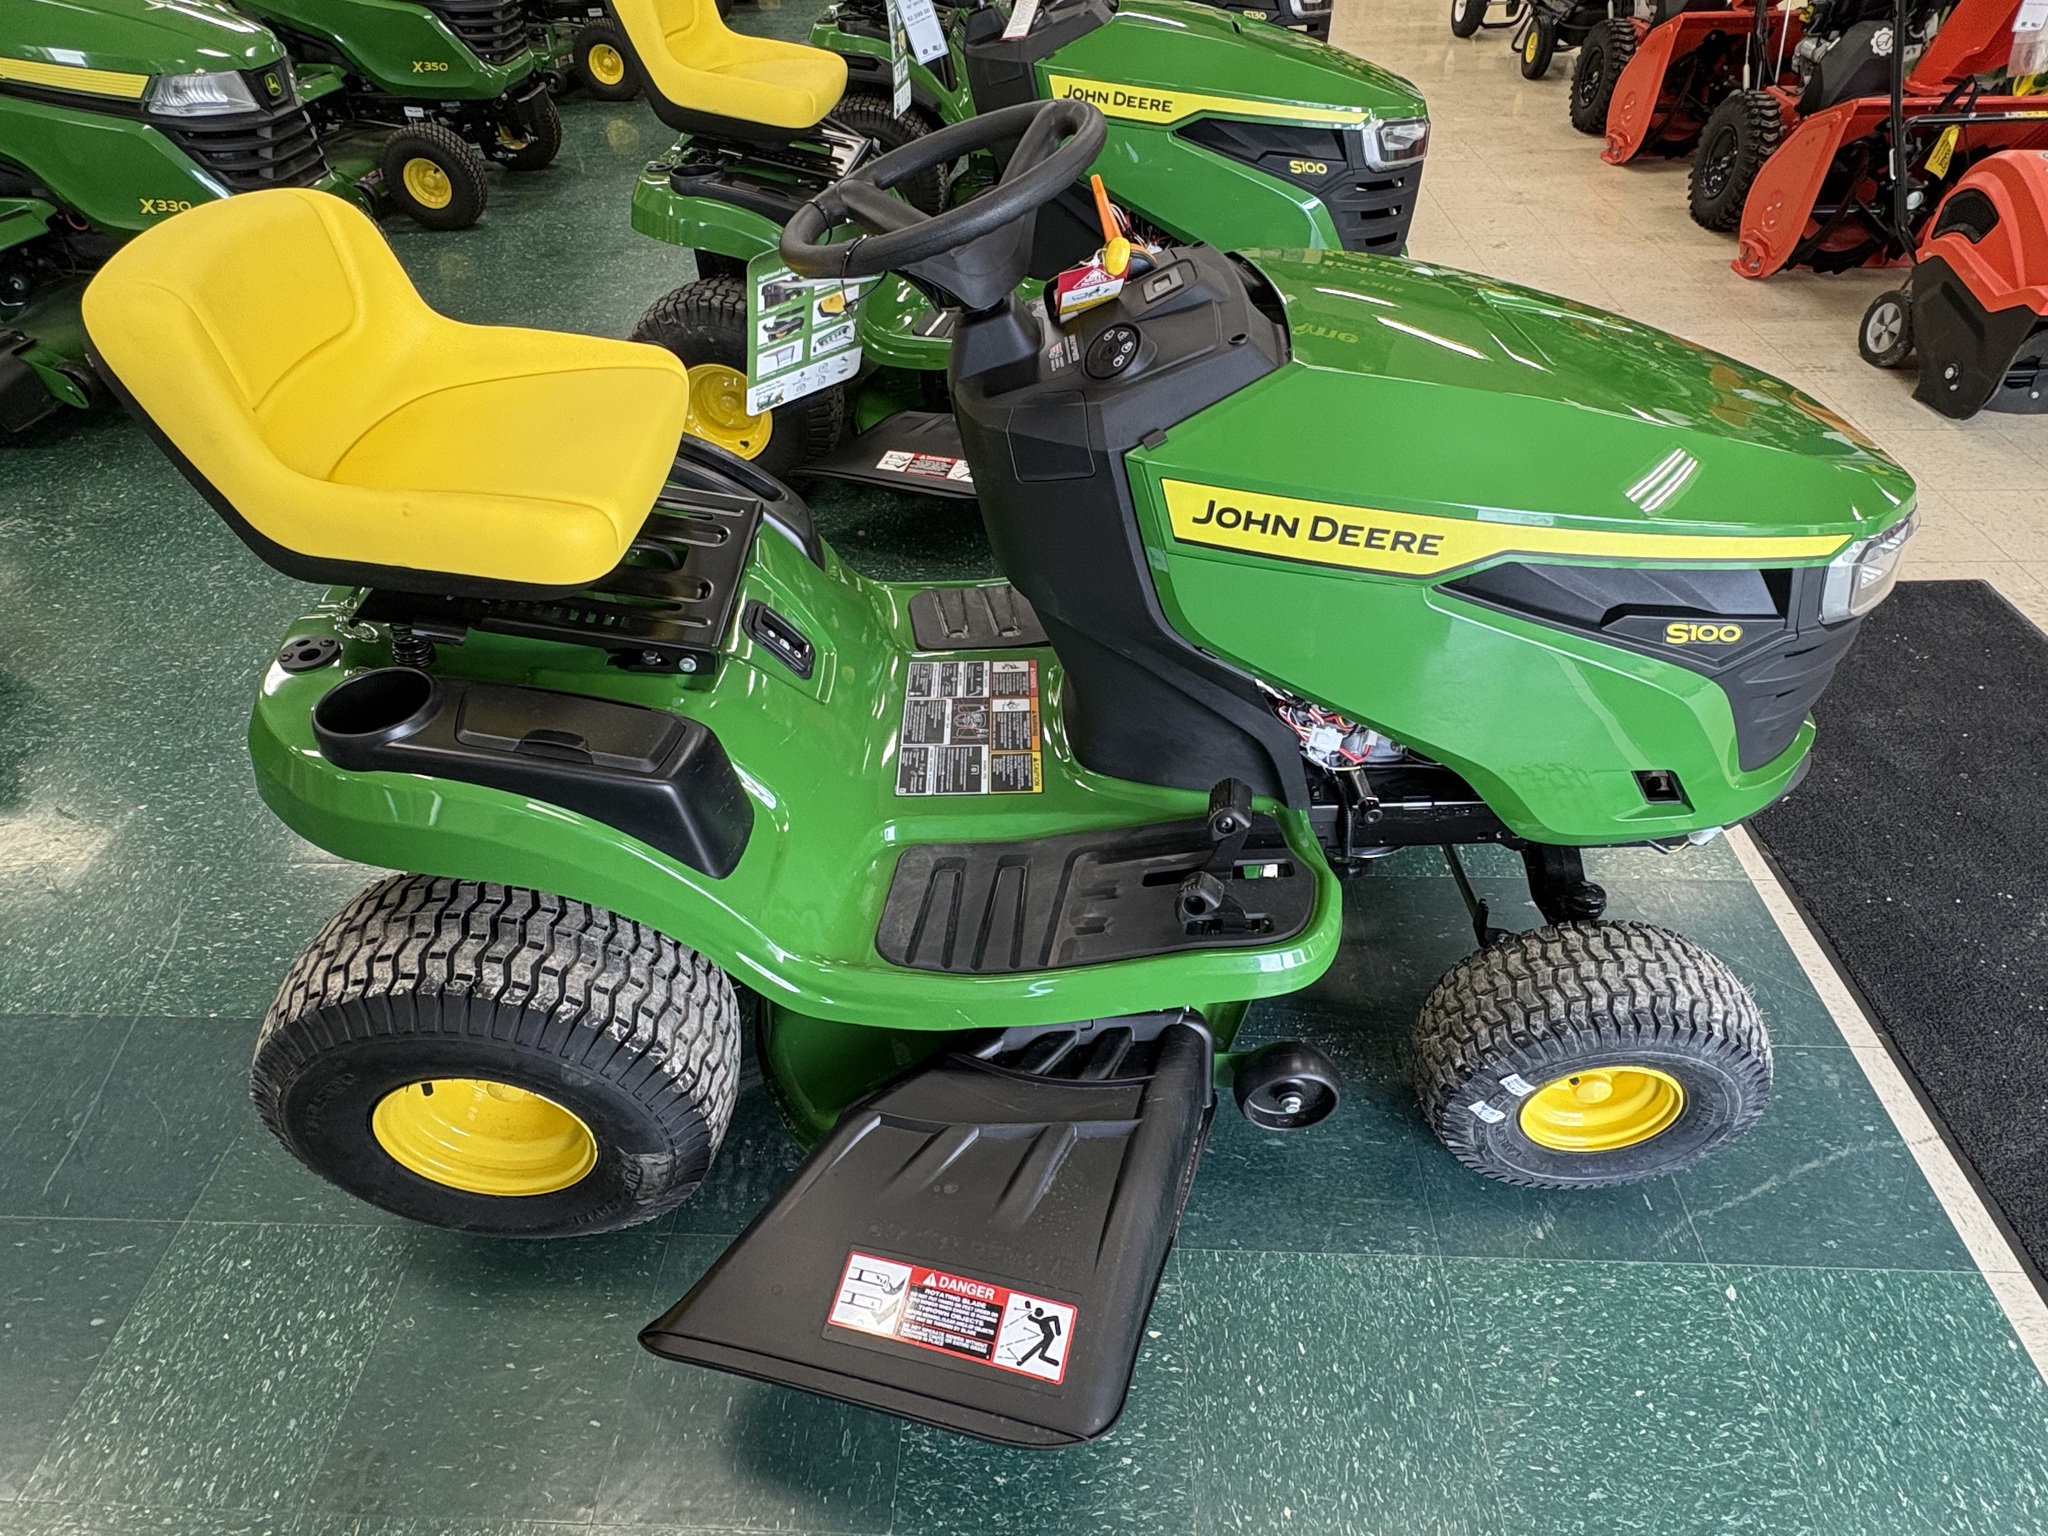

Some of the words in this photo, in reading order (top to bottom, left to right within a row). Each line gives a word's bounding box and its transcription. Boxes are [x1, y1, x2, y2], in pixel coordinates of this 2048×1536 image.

[412, 60, 449, 73] X350
[1062, 85, 1110, 104] JOHN
[1113, 91, 1174, 113] DEERE
[1289, 160, 1328, 174] S100
[139, 198, 192, 215] X330
[1192, 500, 1300, 538] JOHN
[1308, 515, 1445, 556] DEERE
[1663, 621, 1743, 645] S100
[925, 1289, 961, 1303] ROTATING
[962, 1298, 987, 1309] BLADE
[938, 1276, 996, 1301] DANGER
[919, 1305, 950, 1318] THROWN
[950, 1313, 984, 1327] OBJECTS
